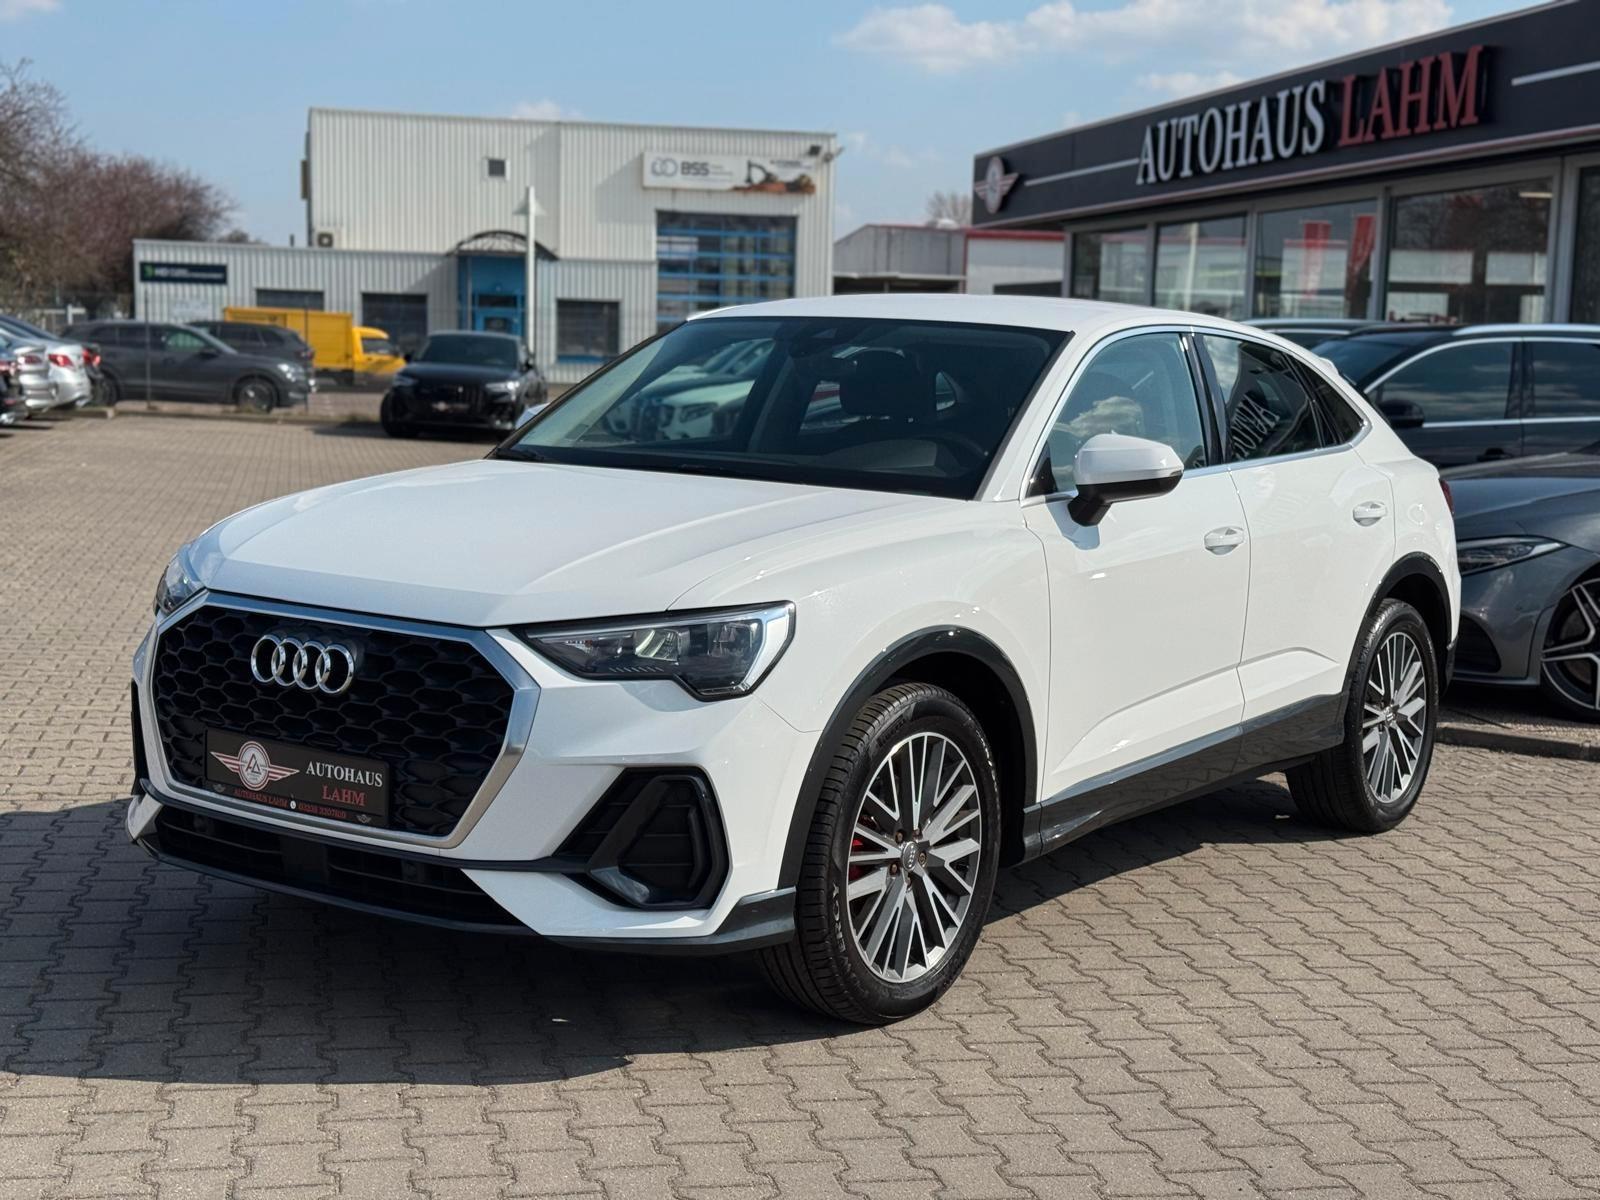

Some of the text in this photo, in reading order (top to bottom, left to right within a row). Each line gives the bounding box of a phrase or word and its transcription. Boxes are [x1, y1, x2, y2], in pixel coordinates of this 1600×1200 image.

[1136, 45, 1483, 186] AUTOHAUS LAHM
[680, 161, 710, 176] BSS
[305, 760, 383, 788] AUTOHAUS
[322, 785, 367, 807] LAHM
